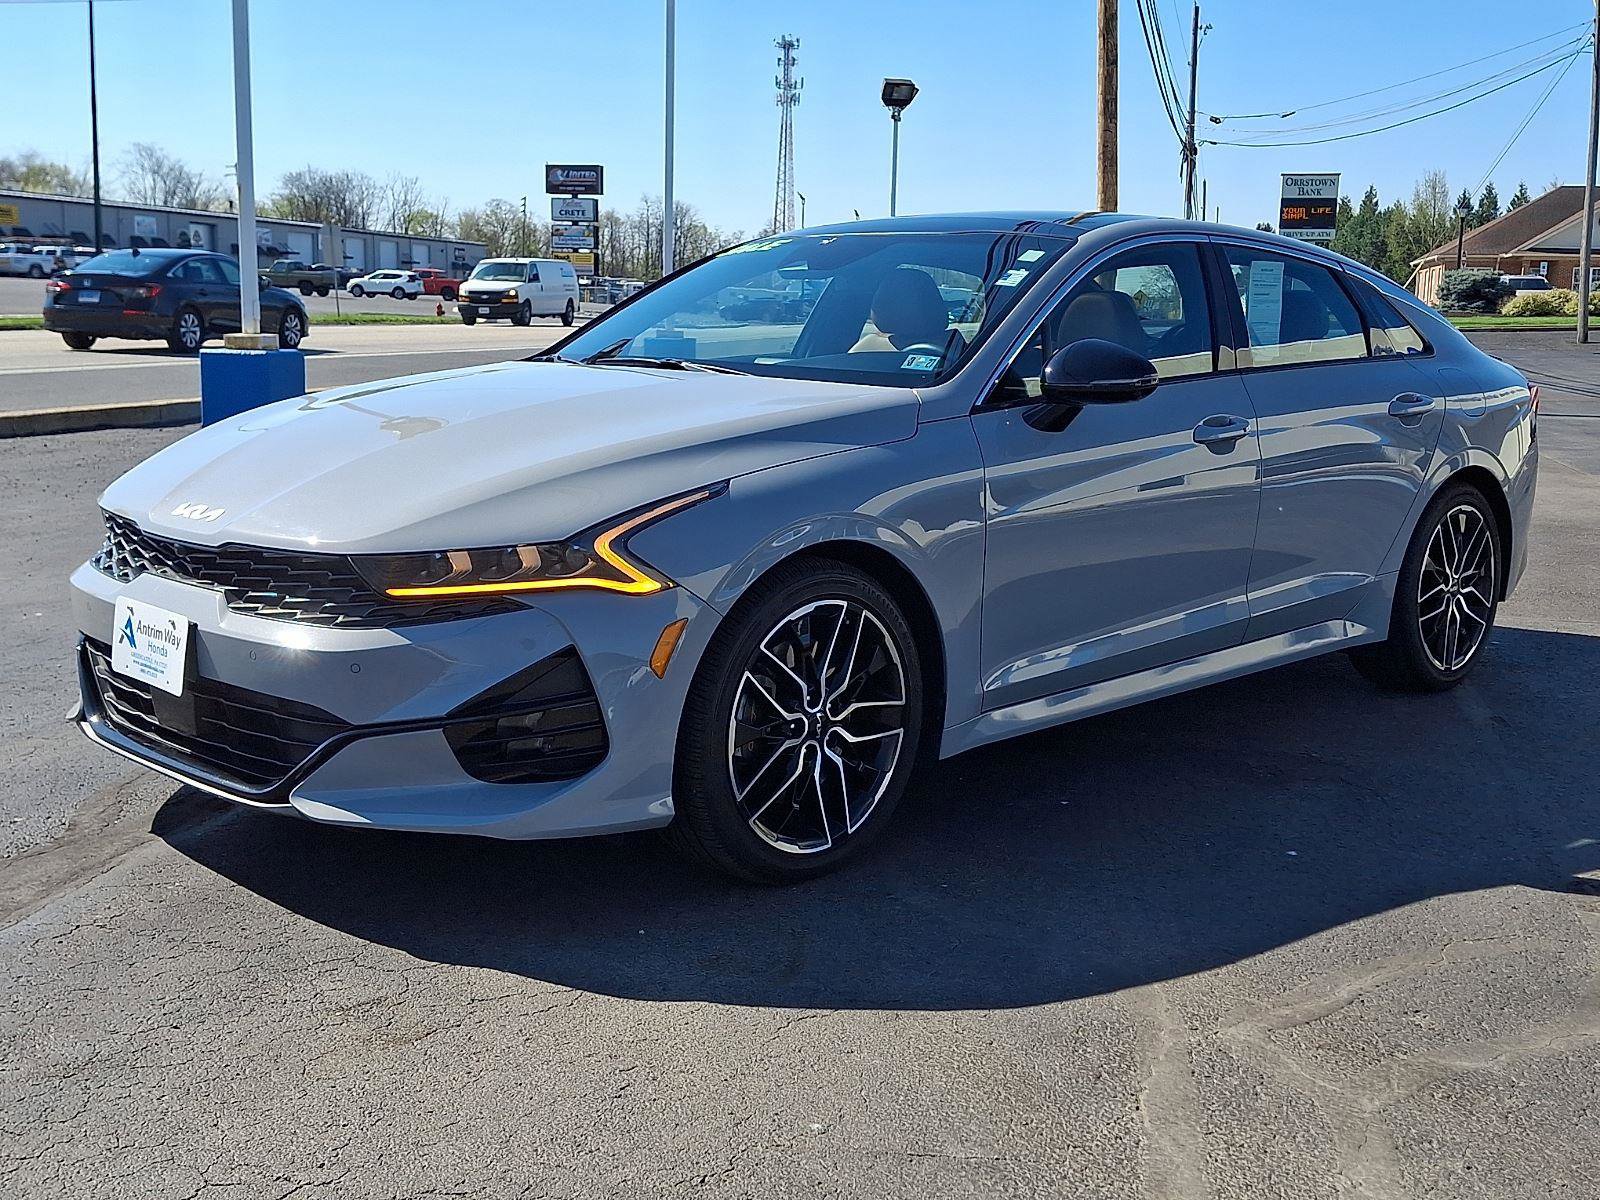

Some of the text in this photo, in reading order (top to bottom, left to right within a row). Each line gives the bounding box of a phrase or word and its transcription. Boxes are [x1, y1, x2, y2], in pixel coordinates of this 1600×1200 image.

[1285, 177, 1336, 186] ORRSTOWN
[1297, 187, 1322, 196] BANK
[559, 209, 587, 217] CRETE
[136, 619, 182, 651] Antrim Way
[147, 640, 168, 658] Honda
